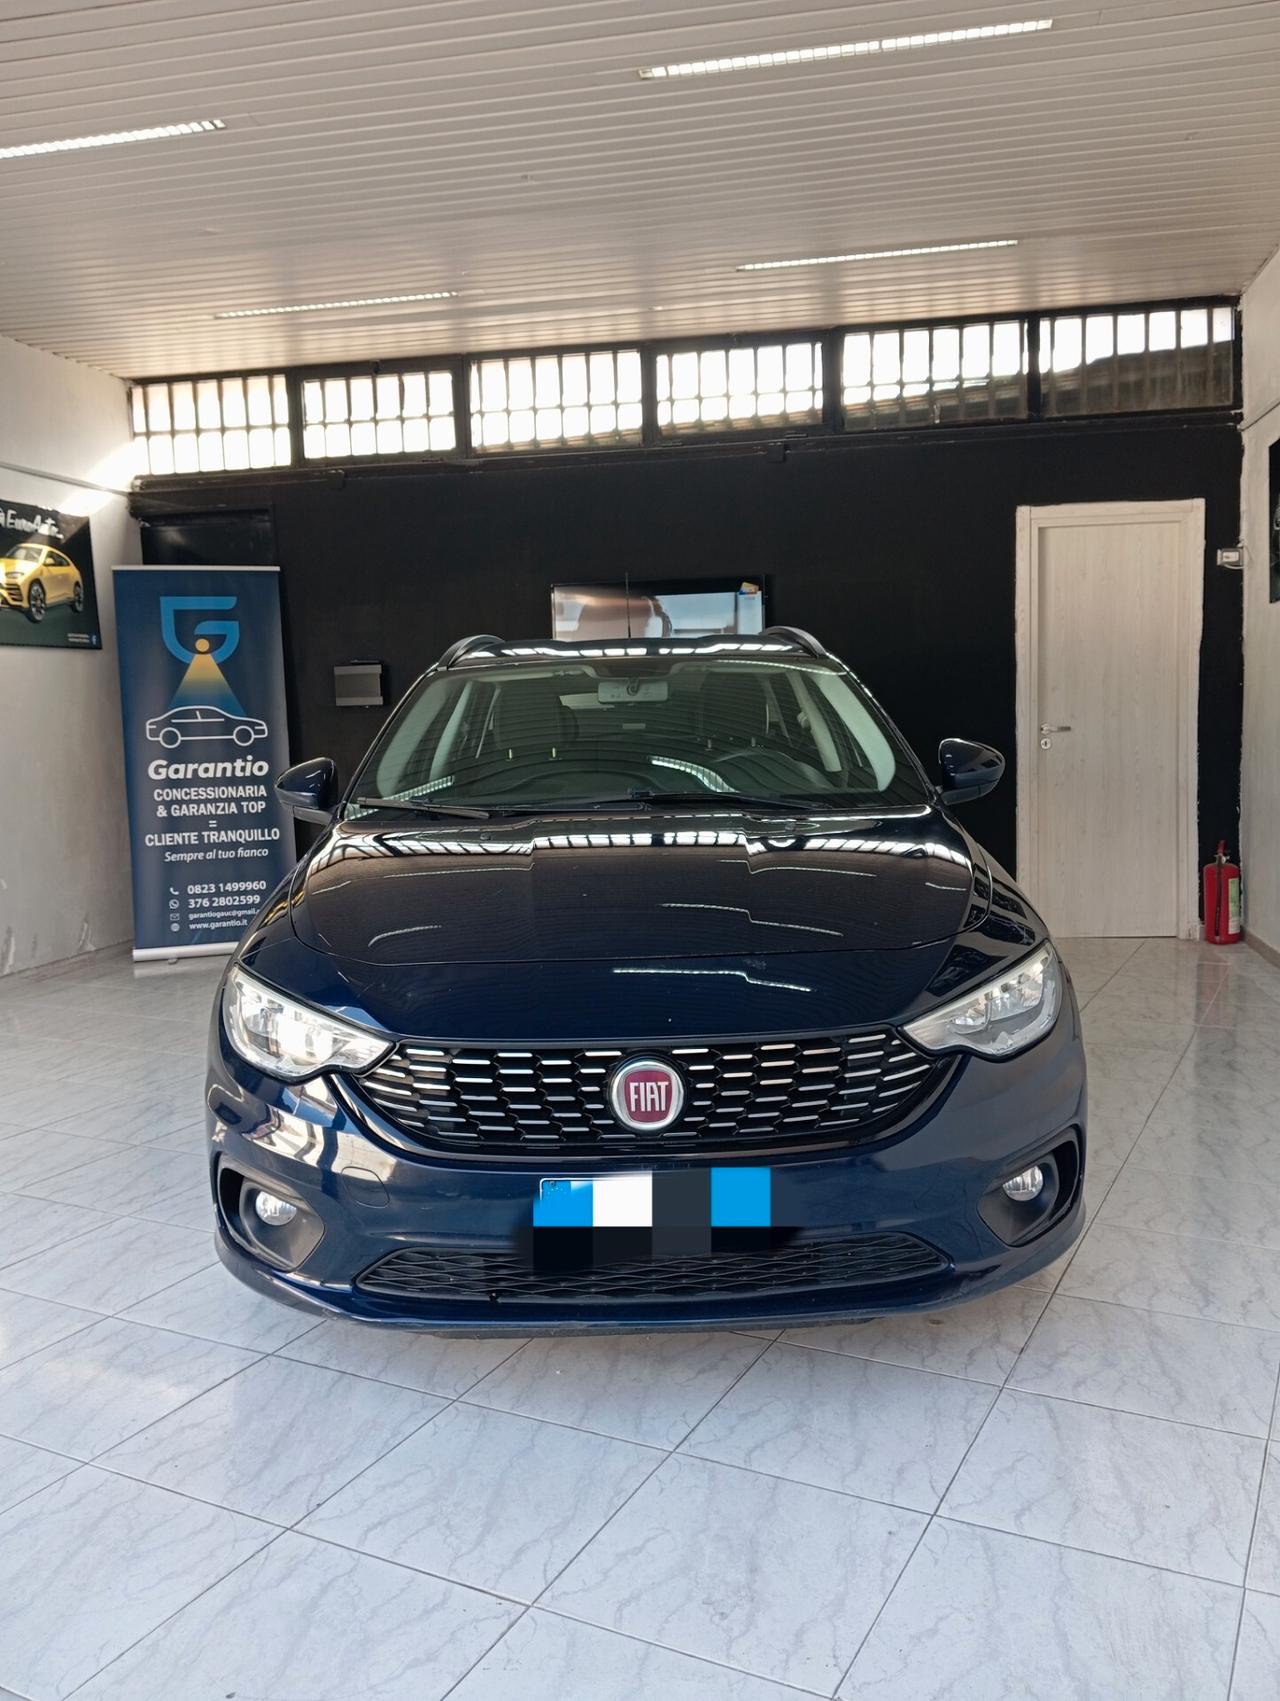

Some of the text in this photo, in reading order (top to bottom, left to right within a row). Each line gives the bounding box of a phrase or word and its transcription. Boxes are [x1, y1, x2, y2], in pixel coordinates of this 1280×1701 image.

[148, 755, 269, 780] Garantio
[153, 785, 267, 801] CONCESSIONARIA
[156, 801, 267, 818] & GARANZIA TOP
[144, 828, 280, 847] CLIENTE TRANQUILLO
[164, 847, 269, 864] Sempre al tuo fianco
[187, 880, 267, 895] 0823 1499960
[188, 894, 261, 909] 376 2802599
[189, 919, 248, 930] www.garantio.it
[629, 1081, 669, 1112] FIAT
